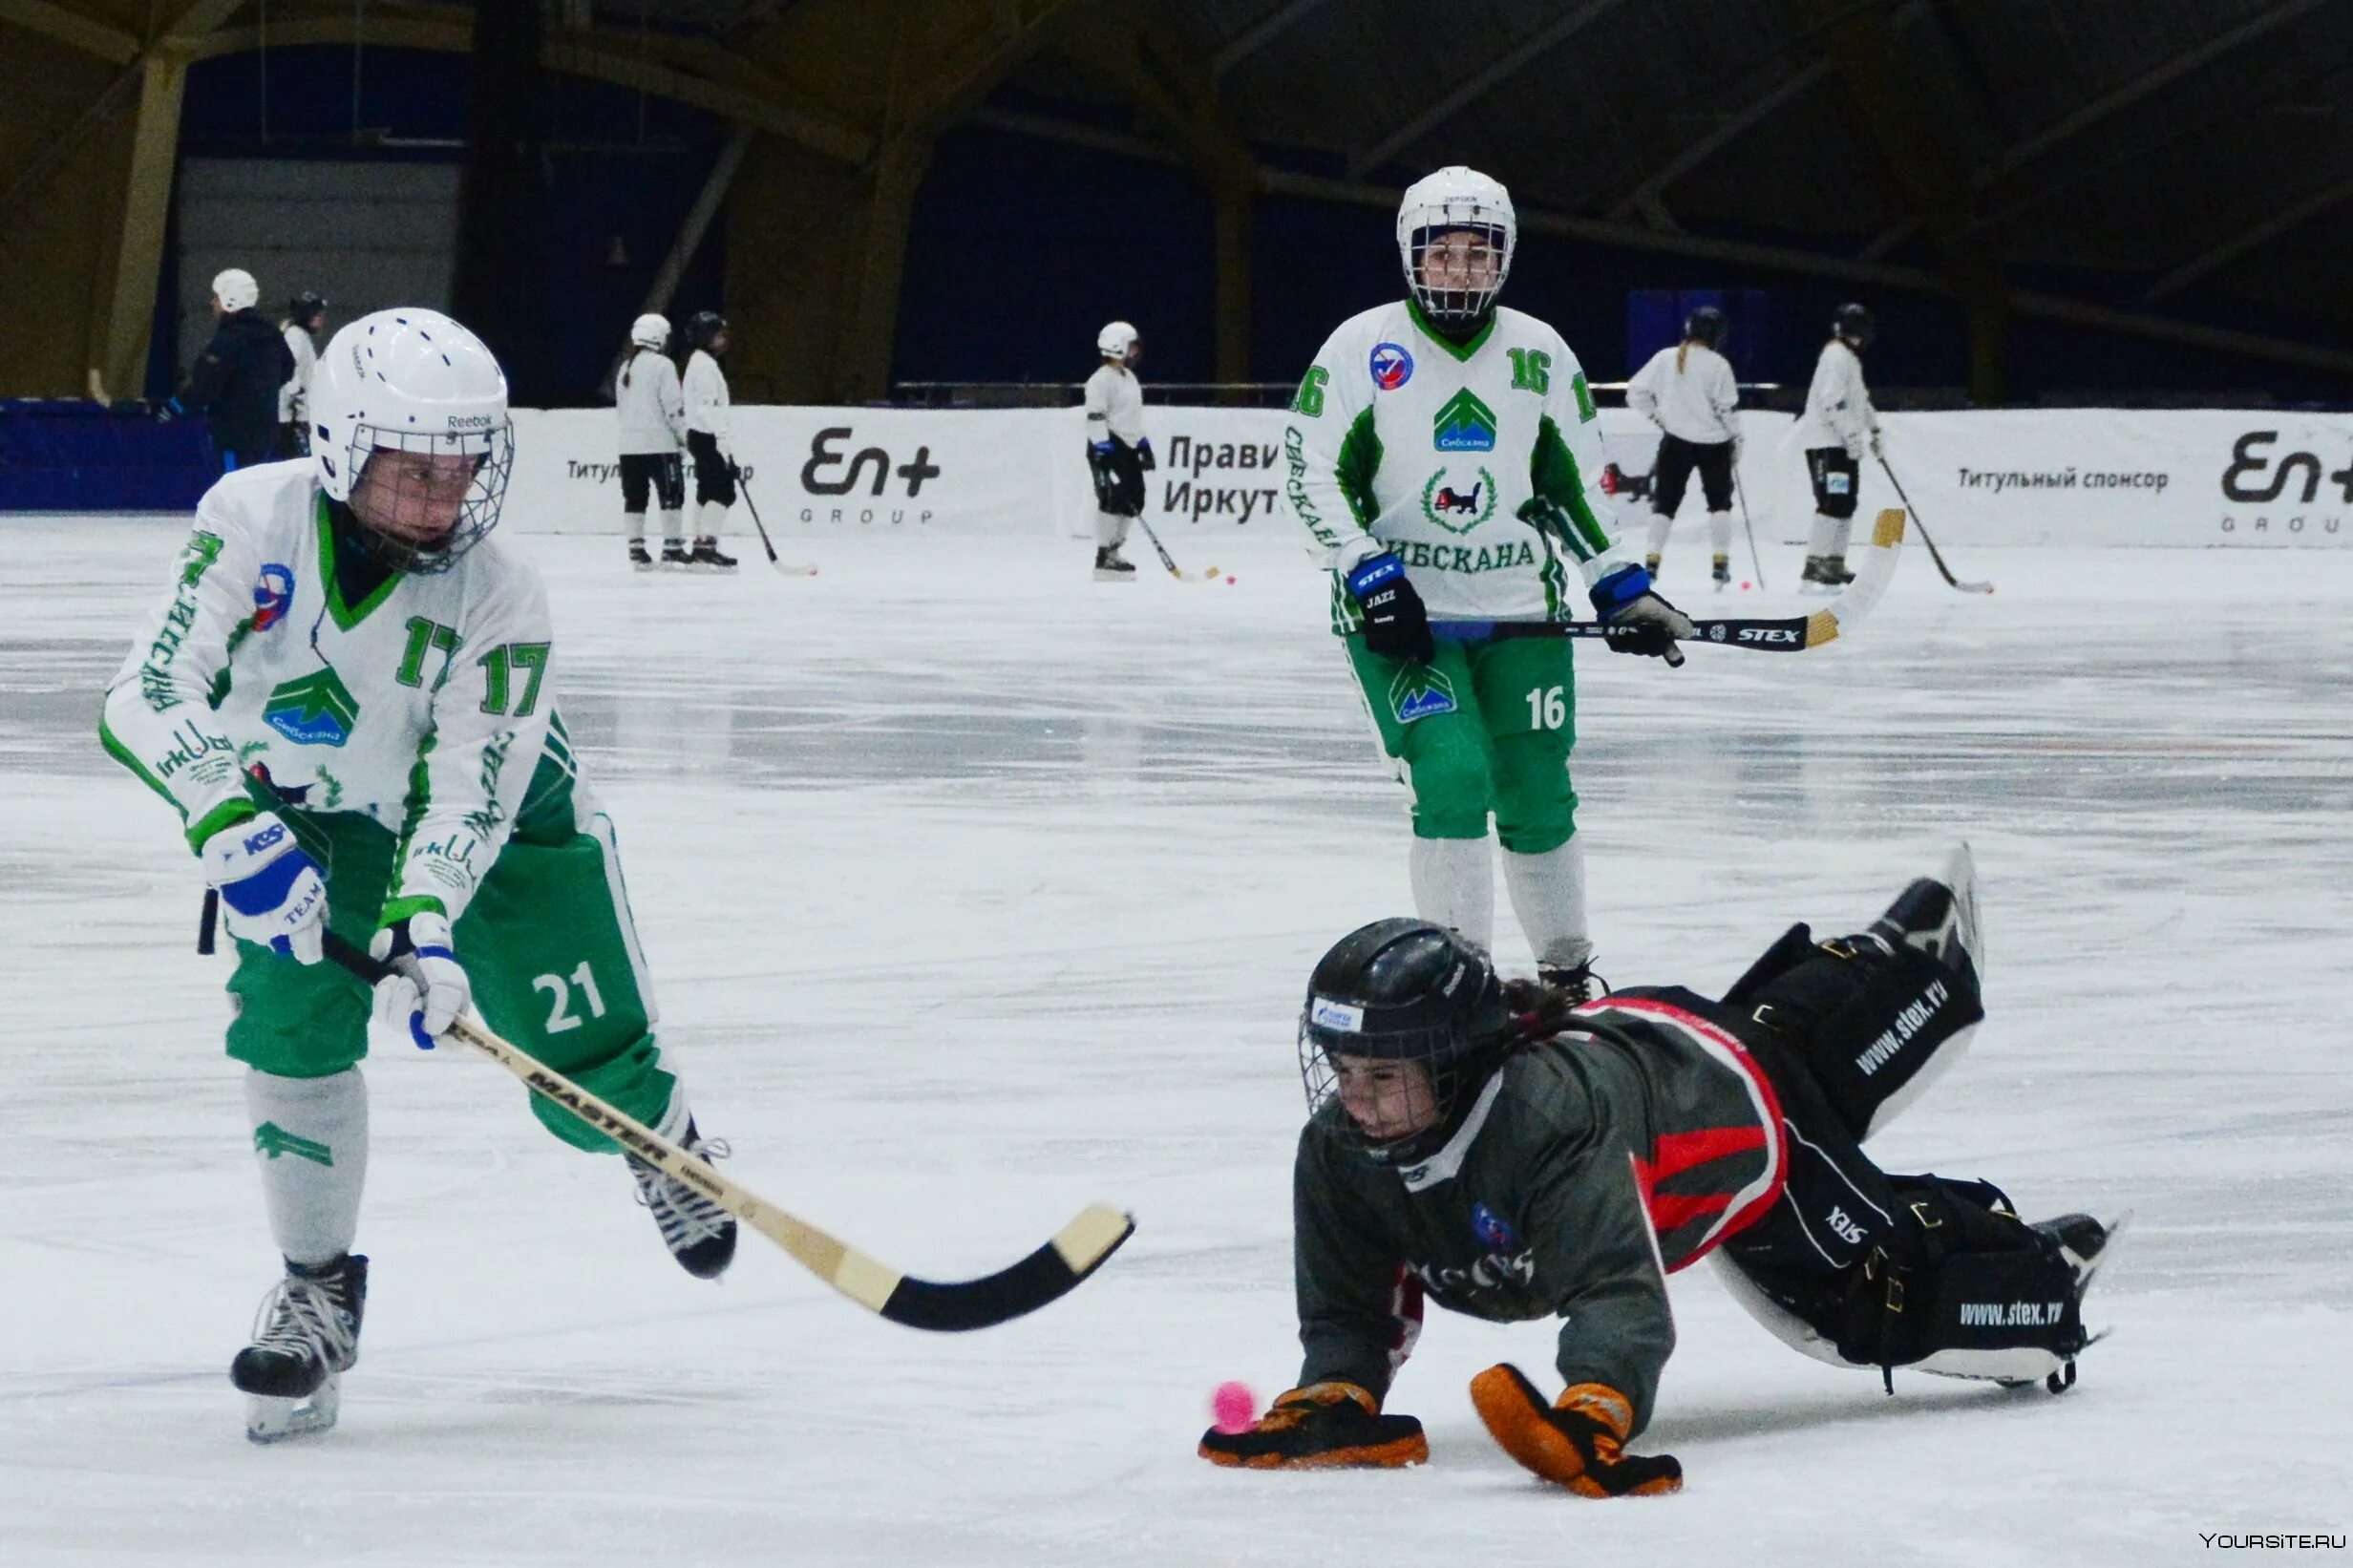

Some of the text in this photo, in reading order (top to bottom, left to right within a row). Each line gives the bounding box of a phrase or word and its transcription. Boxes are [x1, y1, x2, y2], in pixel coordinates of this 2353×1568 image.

[1290, 364, 1329, 418] 6
[1506, 348, 1550, 396] 16
[448, 414, 493, 428] Reebok
[1959, 467, 2169, 494] Титульный спонсор
[800, 508, 932, 523] GROUP
[1163, 480, 1278, 524] Иркут
[1358, 562, 1395, 588] STEX
[1387, 539, 1535, 574] ИБСКАНА
[1367, 589, 1396, 608] JAZZ
[1738, 628, 1800, 643] STEX
[477, 641, 552, 716] 17
[1526, 685, 1566, 731] 16
[284, 882, 322, 925] TEAM
[532, 960, 606, 1034] 21
[527, 1071, 668, 1162] MASTER
[1825, 1205, 1869, 1244] STEX
